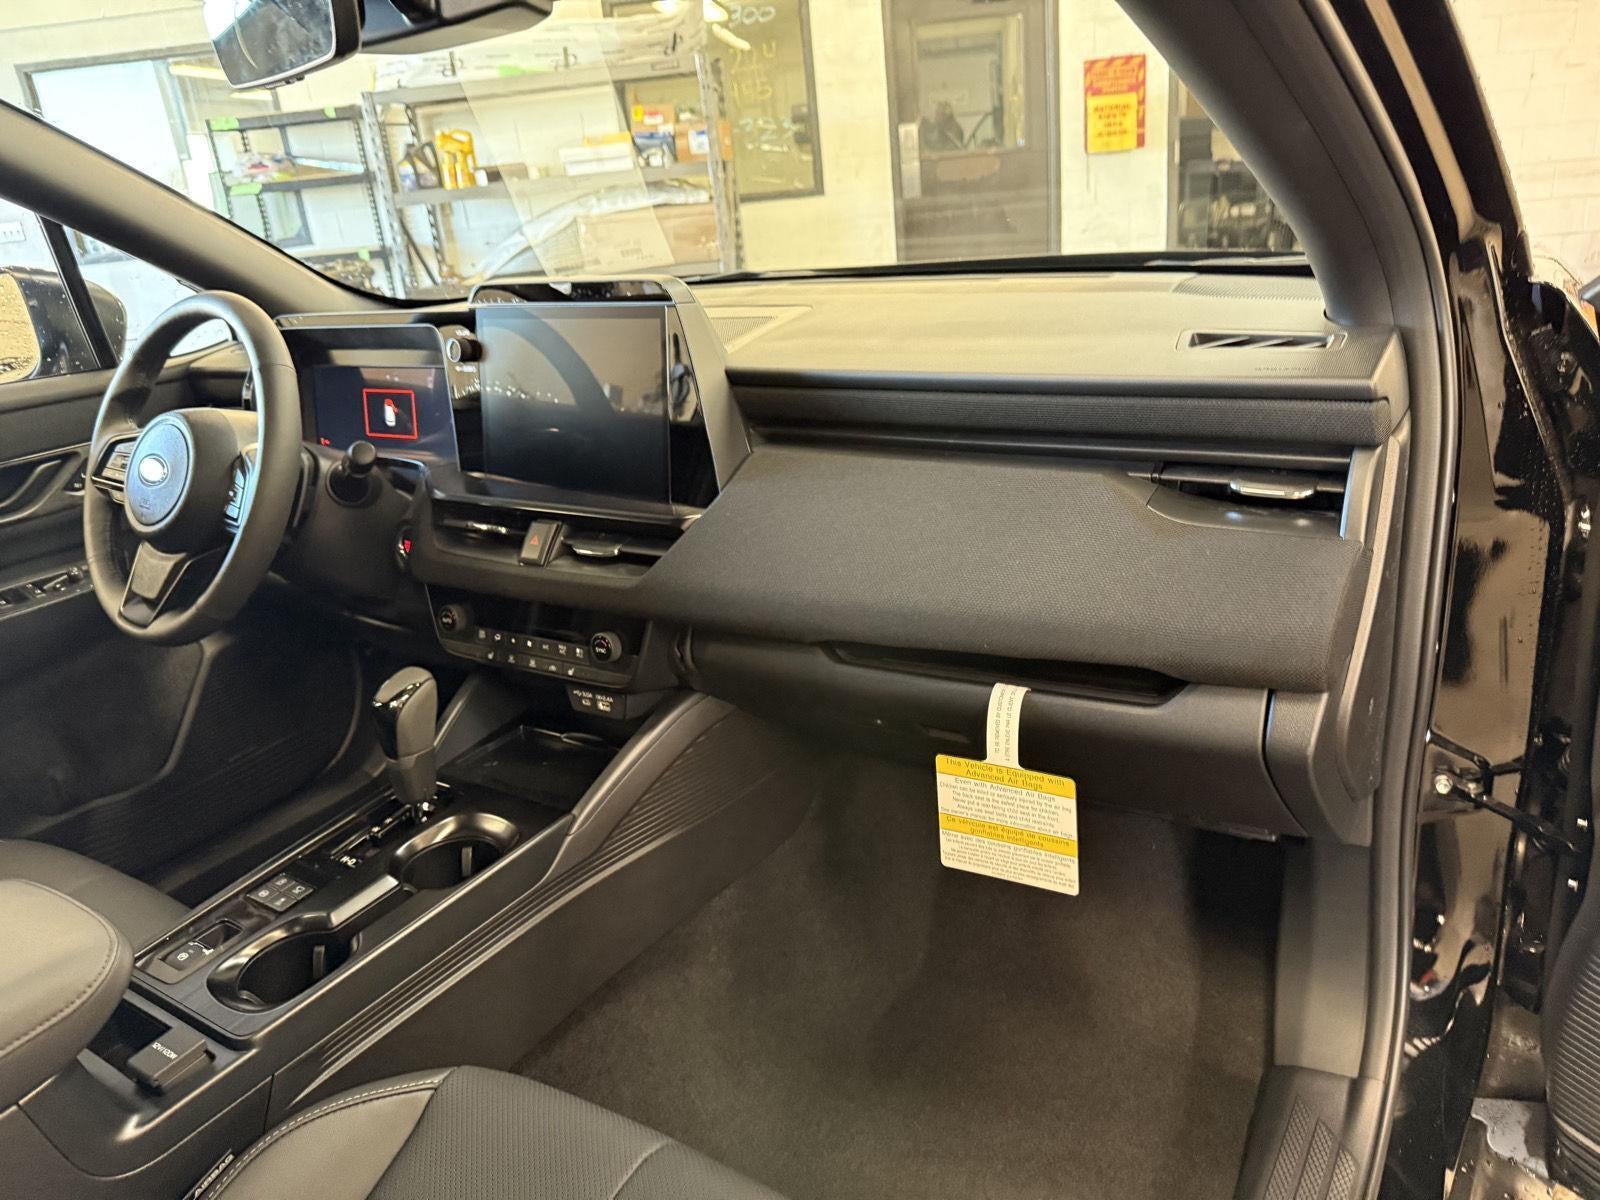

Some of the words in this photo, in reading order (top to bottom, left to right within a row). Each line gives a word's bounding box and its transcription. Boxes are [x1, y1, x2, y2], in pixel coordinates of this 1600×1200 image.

[945, 757, 961, 766] This
[964, 761, 993, 772] Vehicle
[1006, 769, 1044, 783] Equipped
[1047, 776, 1064, 786] with
[965, 769, 1003, 782] Advanced
[1007, 777, 1017, 785] Air
[1021, 779, 1042, 791] Bags
[954, 777, 971, 785] Even
[973, 780, 987, 788] with
[989, 783, 1025, 796] Advanced
[1025, 790, 1035, 798] Air
[1037, 793, 1055, 802] Bags
